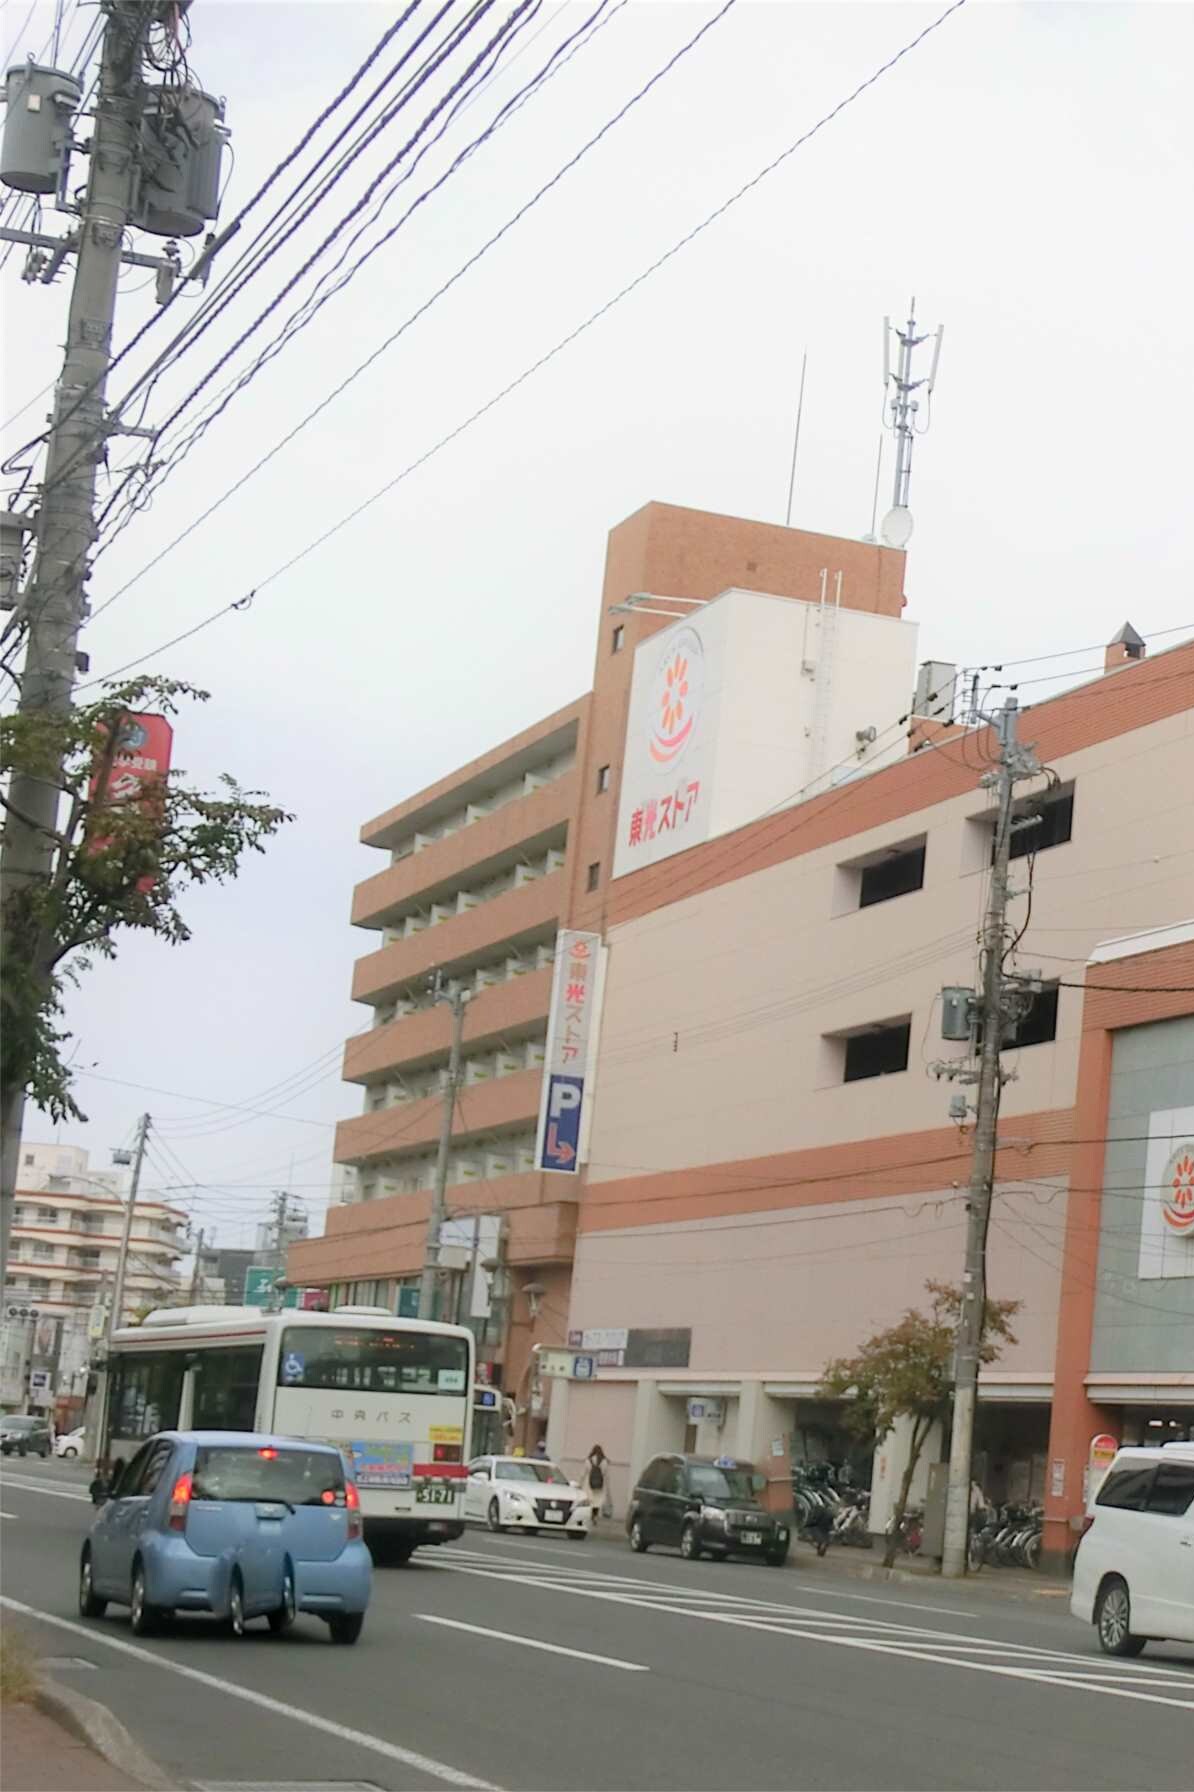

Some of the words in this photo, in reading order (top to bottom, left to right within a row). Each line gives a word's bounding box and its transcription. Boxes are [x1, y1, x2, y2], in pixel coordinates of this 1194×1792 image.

[628, 781, 700, 848] 東光ストア
[331, 1409, 412, 1425] 中央バス
